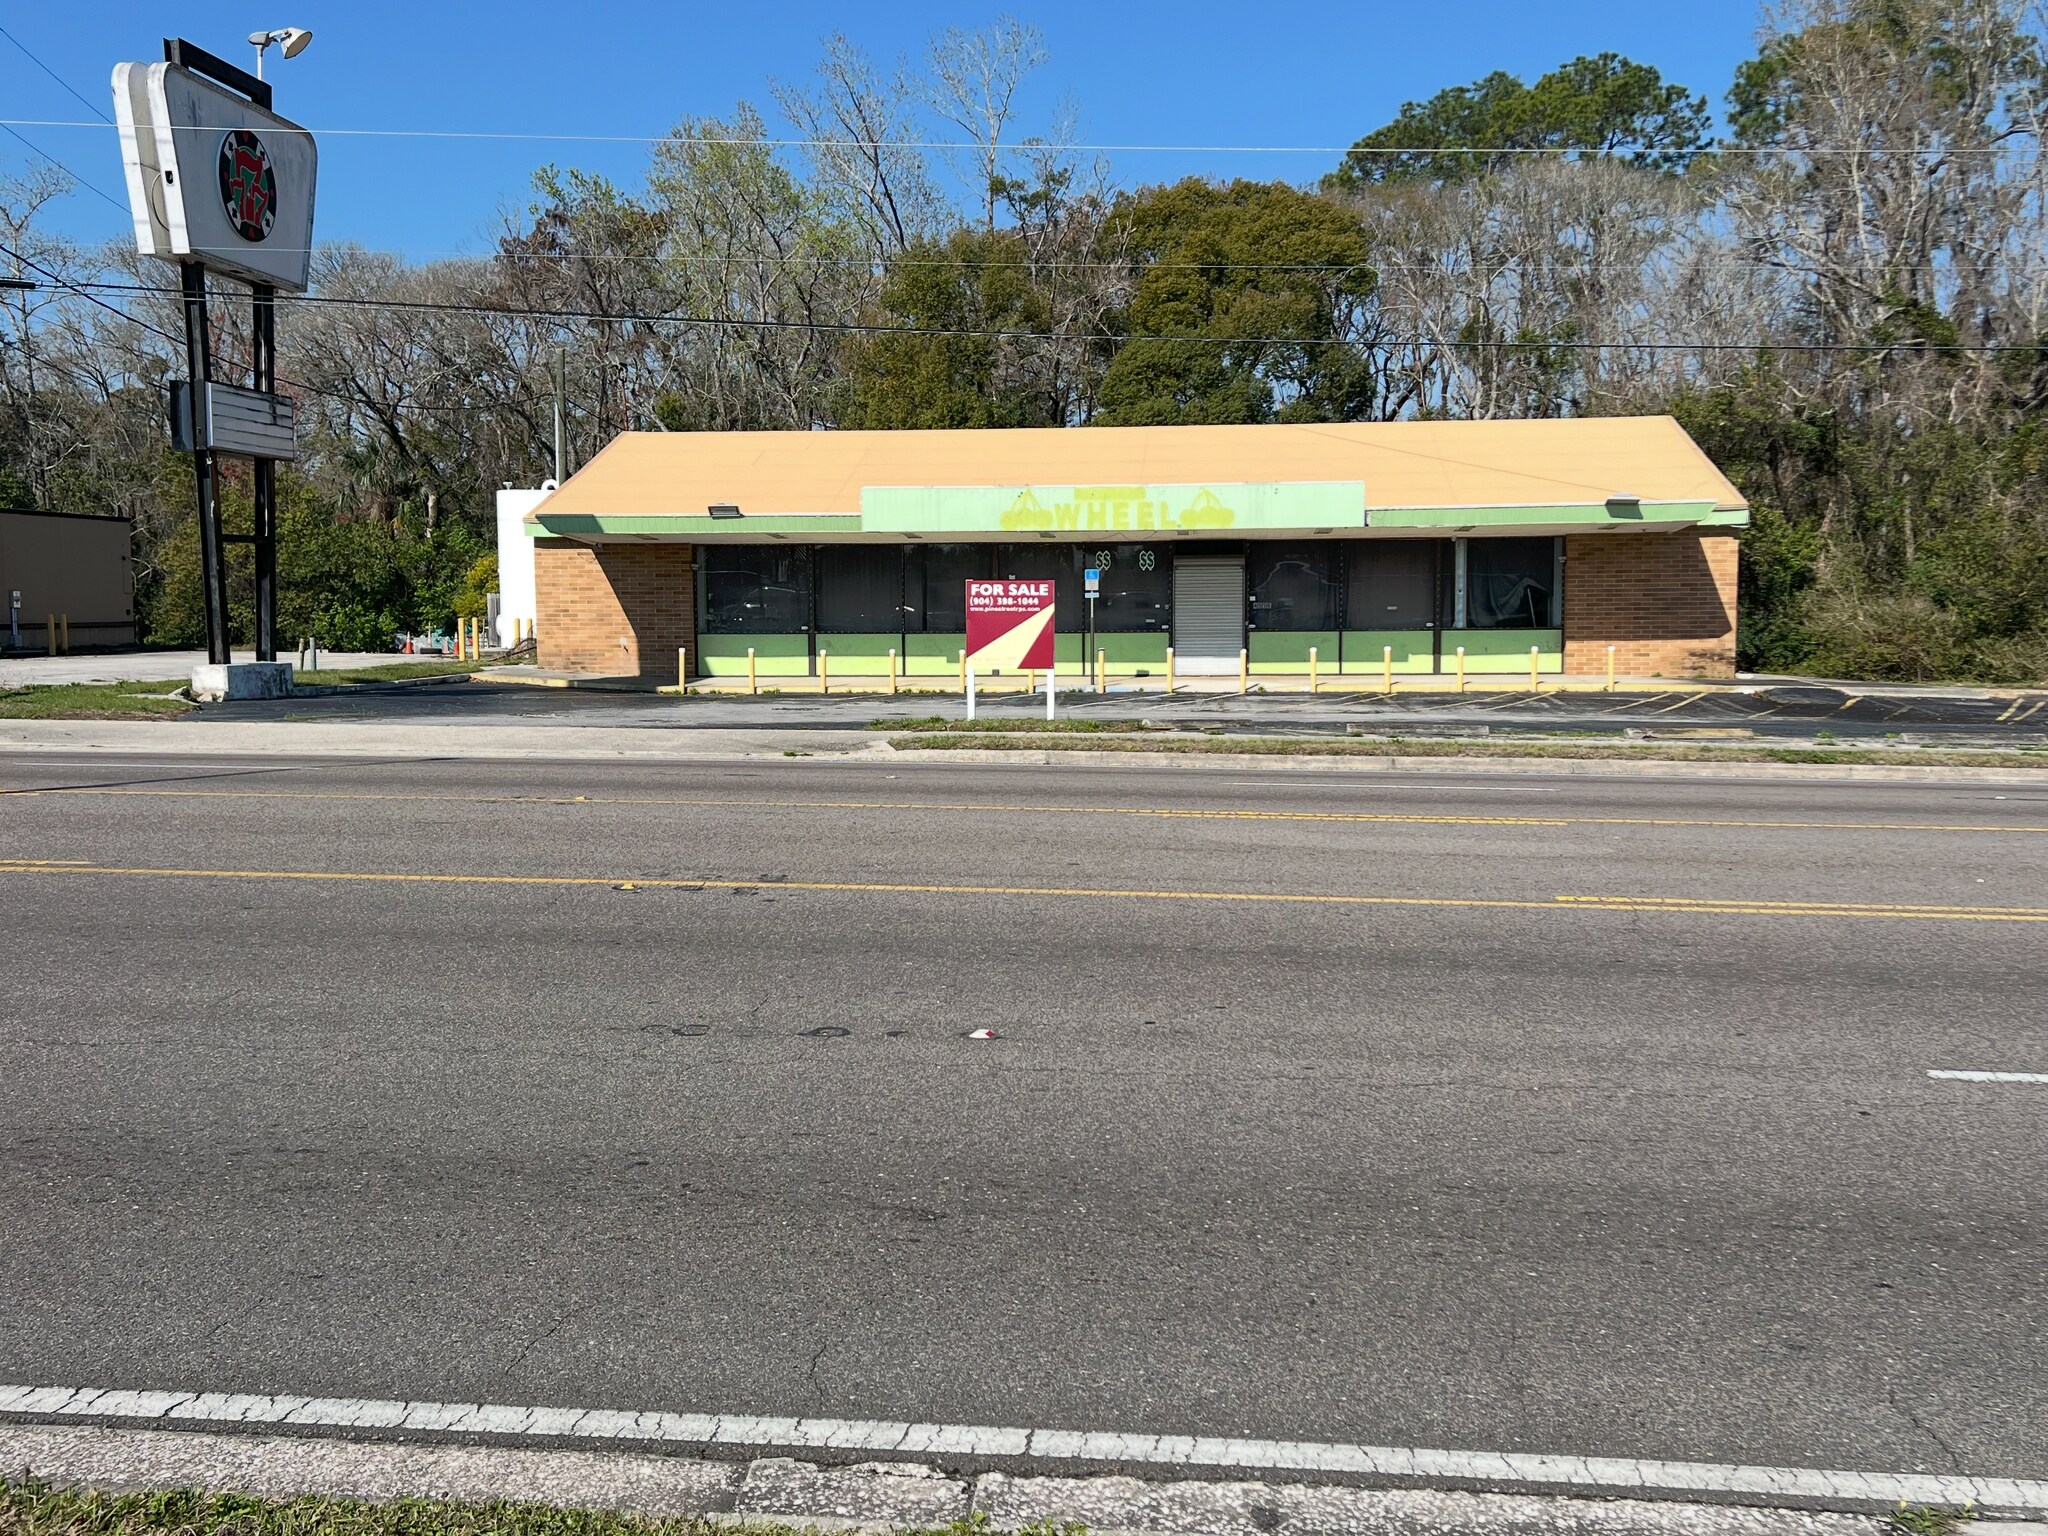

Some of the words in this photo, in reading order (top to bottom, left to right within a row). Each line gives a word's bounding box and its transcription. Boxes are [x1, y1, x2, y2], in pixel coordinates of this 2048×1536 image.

[1054, 501, 1177, 530] WHEEL
[971, 584, 1004, 596] FOR
[1008, 584, 1049, 596] SALE
[970, 596, 993, 606] (904)
[997, 597, 1039, 605] 398-1044
